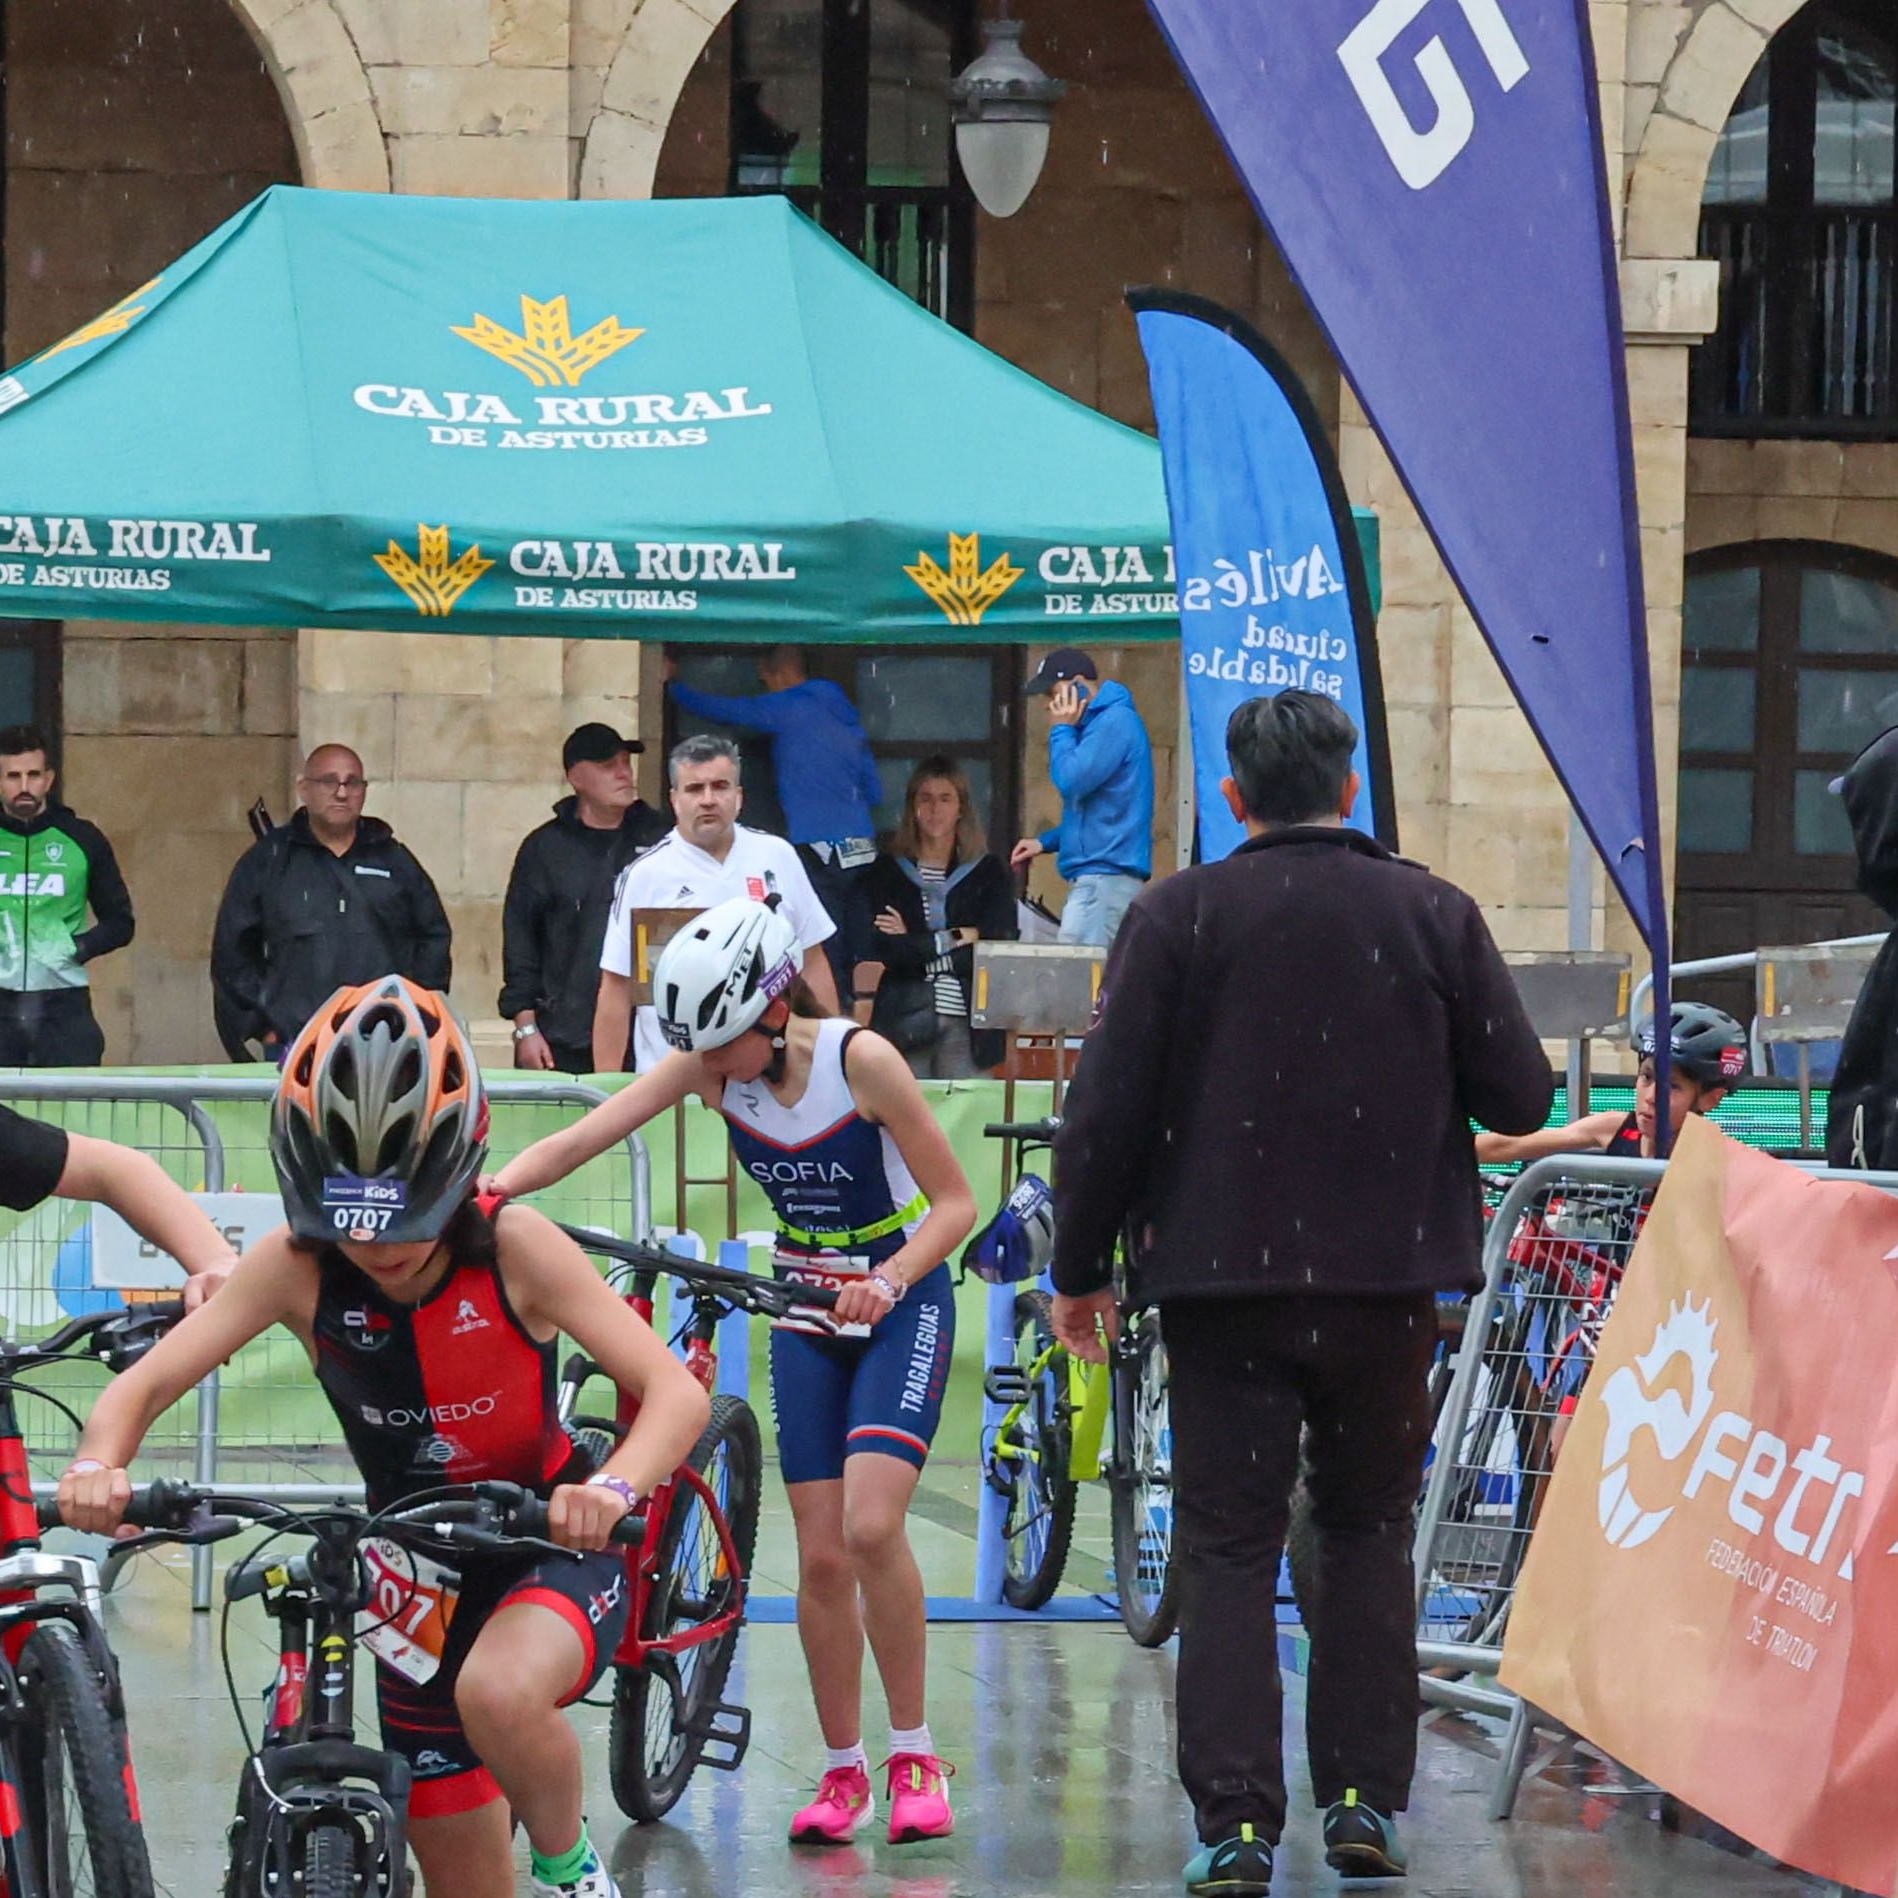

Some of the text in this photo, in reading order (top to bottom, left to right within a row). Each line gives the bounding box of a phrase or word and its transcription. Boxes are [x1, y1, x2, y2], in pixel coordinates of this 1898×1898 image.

[353, 384, 773, 426] CAJA RURAL
[426, 426, 708, 450] DE ASTURIAS
[108, 519, 271, 562] RURAL
[509, 540, 796, 582] CAJA RURAL
[1038, 546, 1154, 587] CAJA
[32, 565, 171, 590] ASTURIAS
[515, 586, 698, 611] DE ASTURIAS
[1044, 593, 1180, 615] DE ASTUR
[750, 1161, 854, 1184] SOFIA
[332, 1207, 393, 1231] 0707
[900, 1302, 941, 1413] TRAGALEGUAS
[387, 1396, 496, 1427] OVIEDO
